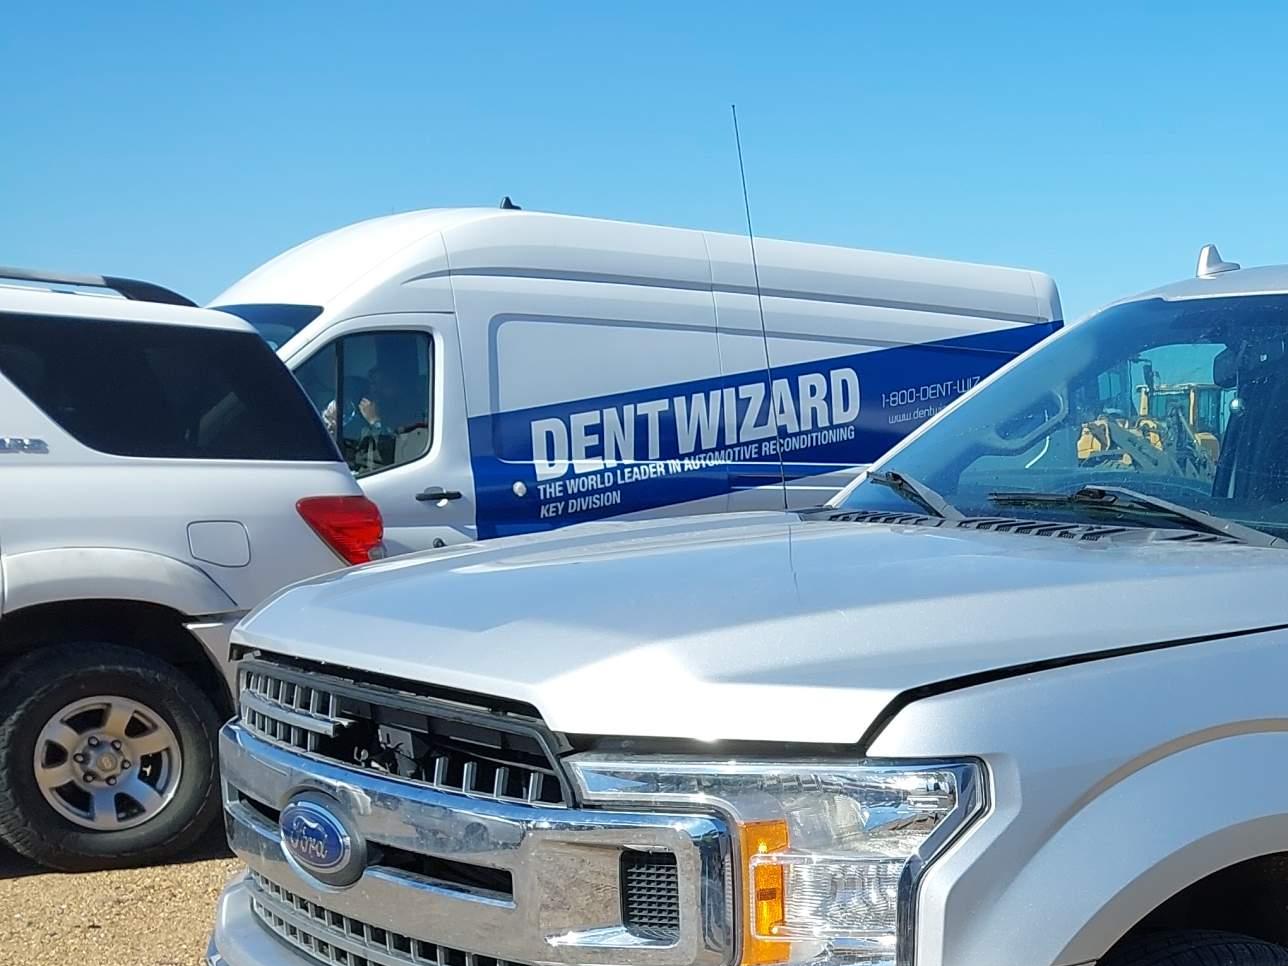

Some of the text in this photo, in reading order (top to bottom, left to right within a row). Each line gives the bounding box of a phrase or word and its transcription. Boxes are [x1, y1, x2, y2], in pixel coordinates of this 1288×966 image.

[881, 376, 981, 408] 1-800-DENT-WIZ
[531, 367, 860, 481] DENT WIZARD
[537, 425, 855, 500] THE WORLD LEADER IN AUTOMOTIVE RECONDITIONING
[540, 490, 621, 518] KEY DIVISION
[291, 815, 329, 859] Ford
